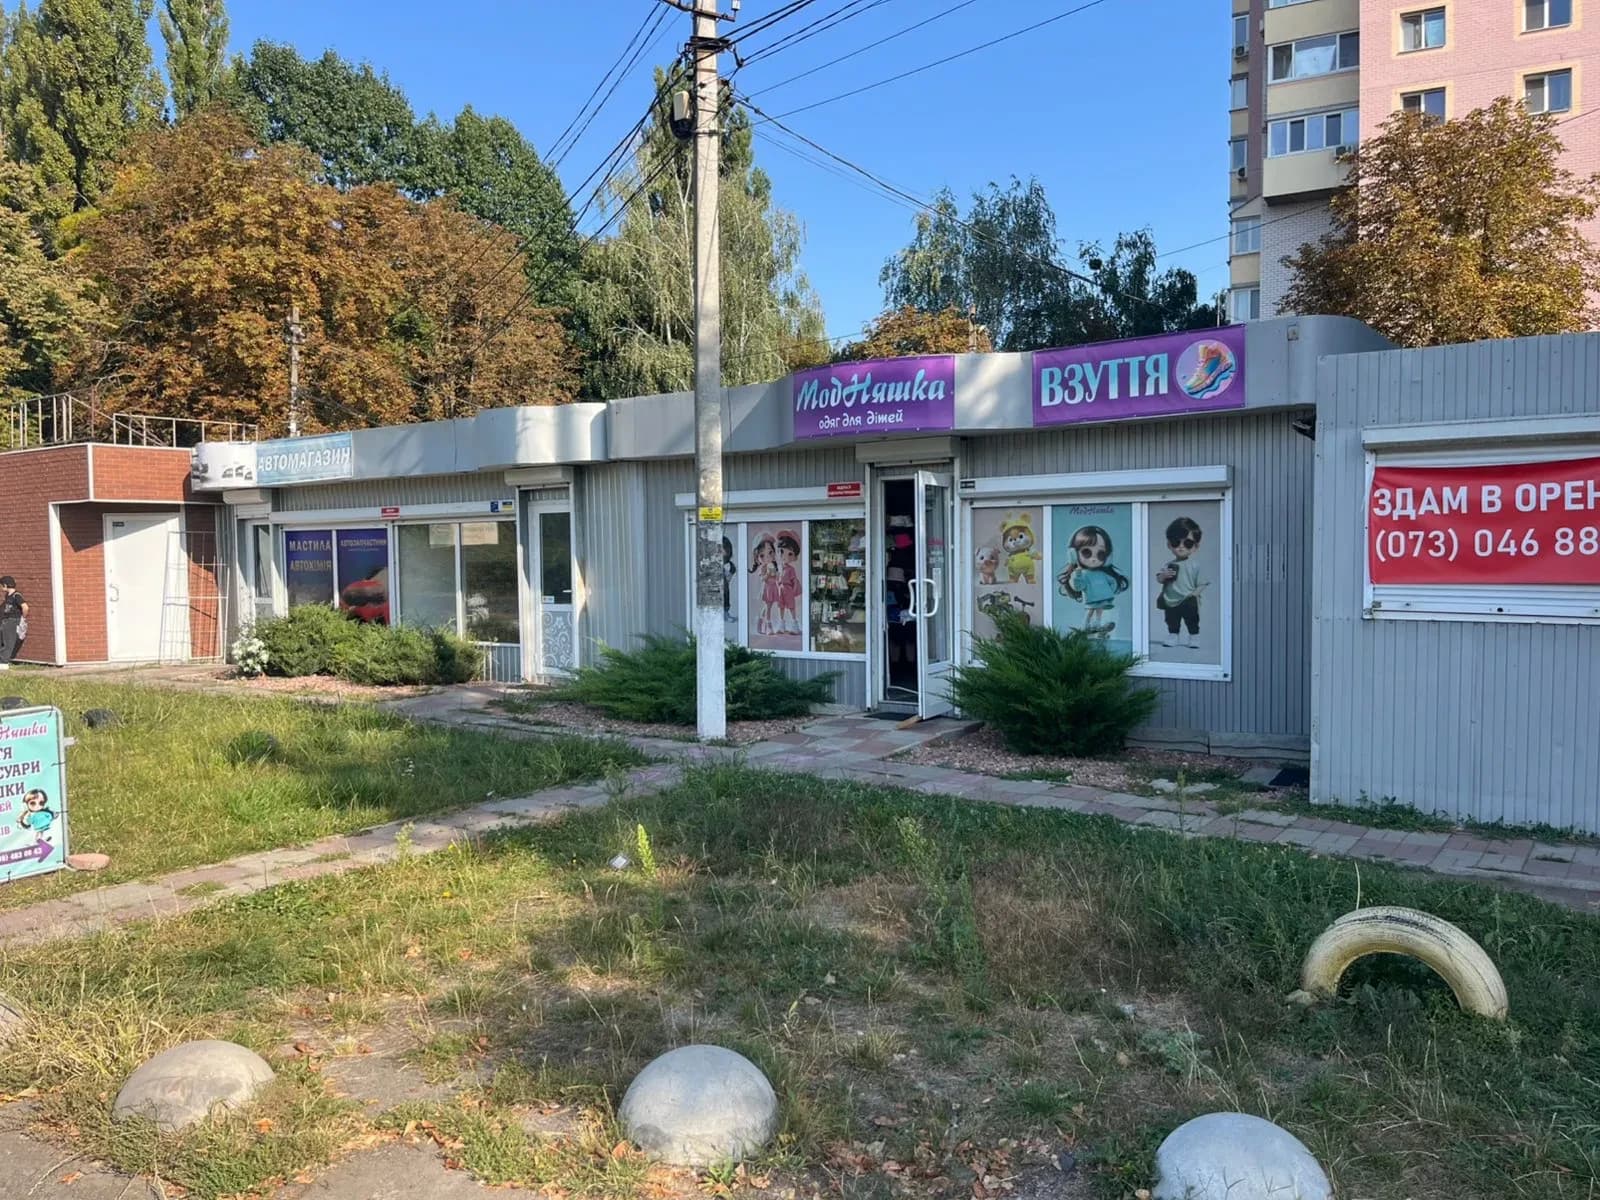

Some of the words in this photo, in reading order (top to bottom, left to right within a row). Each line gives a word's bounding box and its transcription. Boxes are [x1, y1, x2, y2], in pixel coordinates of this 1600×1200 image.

[796, 368, 946, 412] МодНяшка
[1040, 353, 1169, 407] ВЗУТТЯ
[818, 415, 841, 430] одяг
[842, 412, 862, 427] для
[866, 409, 904, 425] дітей
[257, 447, 350, 473] АВТОМАГАЗИН
[1372, 486, 1468, 521] ЗДАМ
[1481, 485, 1502, 513] В
[289, 540, 332, 552] МАСТИЛА
[1375, 528, 1459, 562] (073)
[1474, 528, 1540, 558] 046
[1554, 526, 1599, 556] 88
